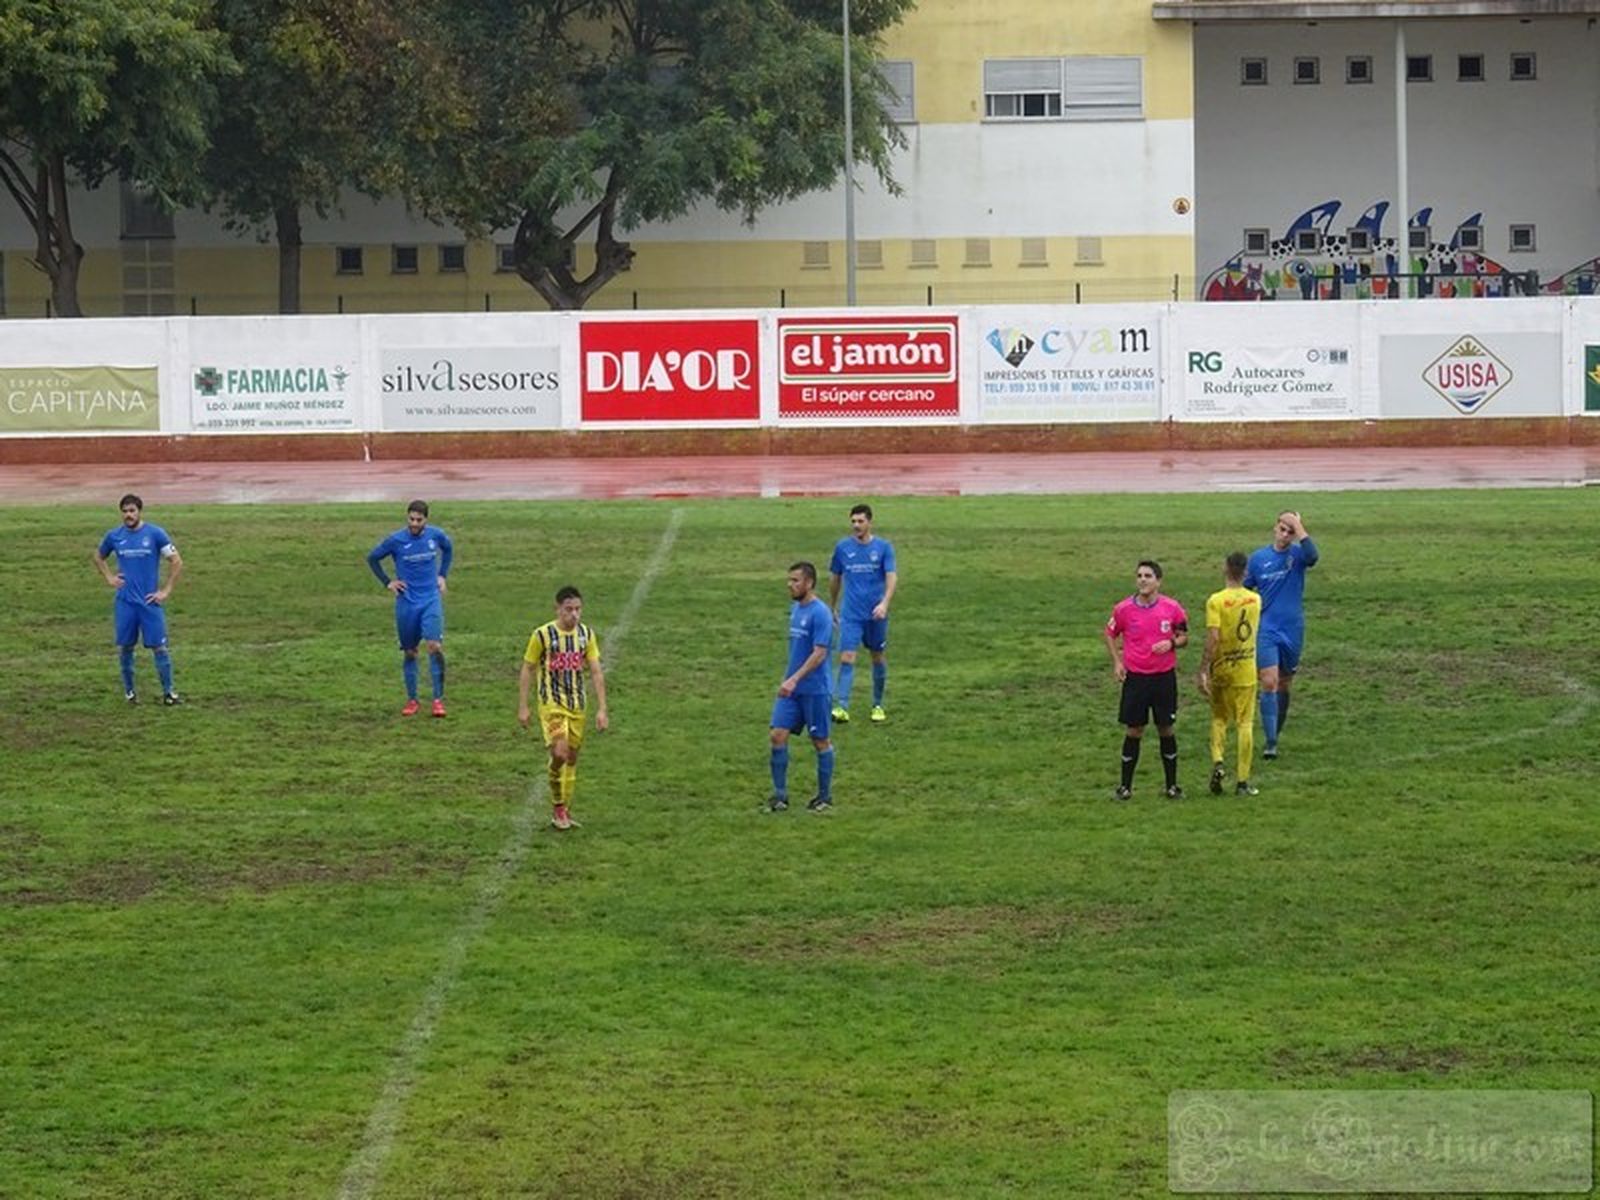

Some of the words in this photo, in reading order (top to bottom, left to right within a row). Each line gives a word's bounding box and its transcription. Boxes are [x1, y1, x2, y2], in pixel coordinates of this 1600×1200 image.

[791, 335, 824, 366] el
[829, 330, 944, 373] jamón
[1041, 327, 1152, 367] cyam
[1188, 351, 1223, 373] RG
[1232, 366, 1305, 379] Autocares
[10, 379, 70, 388] ESPACIO
[227, 367, 329, 394] FARMACIA
[382, 359, 559, 393] silvasesores
[984, 369, 1046, 381] IMPRESIONES
[1051, 368, 1094, 380] TEXTILES
[1098, 368, 1104, 378] Y
[1107, 366, 1155, 378] GRÁFICAS
[1438, 362, 1499, 389] USISA
[802, 387, 817, 401] El
[820, 387, 866, 405] súper
[868, 388, 935, 401] cercano
[1281, 379, 1334, 393] Gómez
[7, 389, 147, 420] CAPITANA
[232, 401, 261, 411] JAIME
[264, 399, 300, 410] MUÑOZ
[303, 399, 345, 409] MÉNDEZ
[405, 404, 537, 416] www.silvaasesores.com
[1237, 609, 1252, 642] 6
